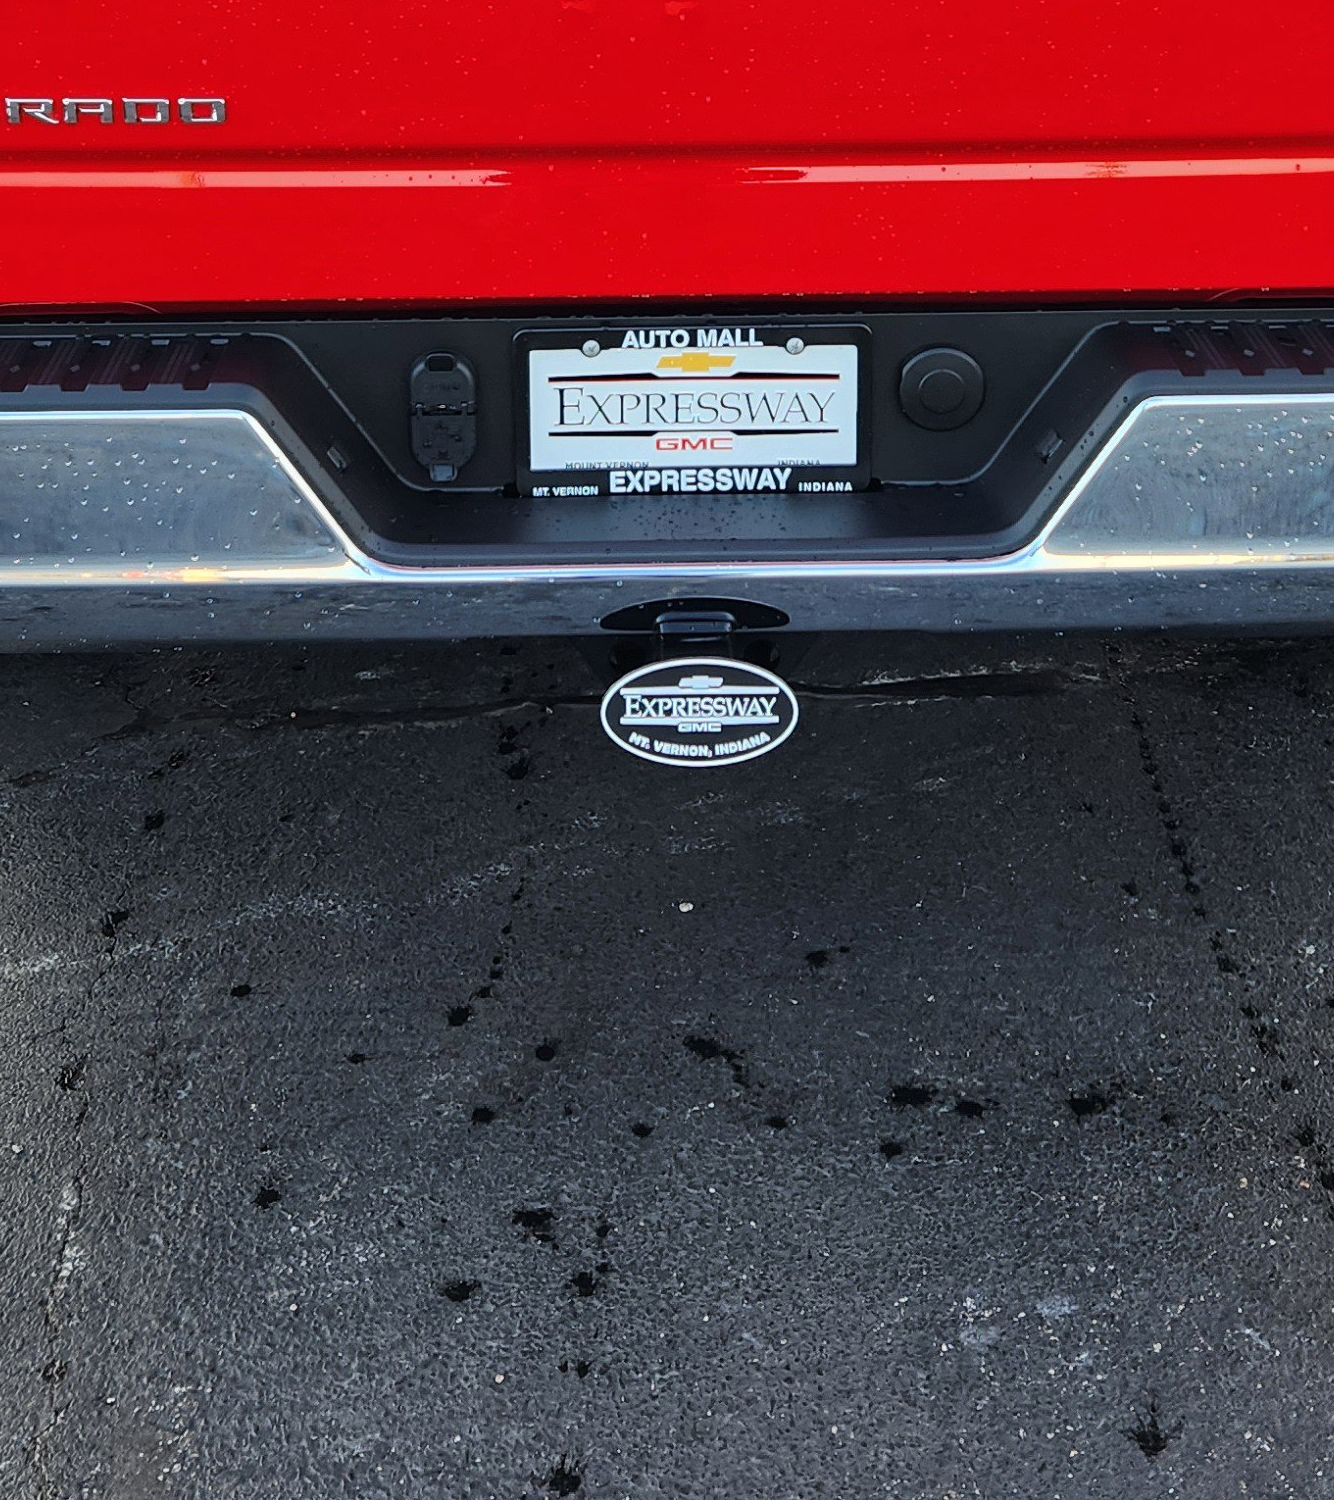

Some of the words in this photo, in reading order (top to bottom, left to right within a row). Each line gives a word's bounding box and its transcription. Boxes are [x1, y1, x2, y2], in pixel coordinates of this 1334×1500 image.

[621, 329, 691, 349] AUTO
[697, 328, 764, 348] MALL
[655, 437, 733, 451] GMC
[565, 462, 602, 470] MOUNT
[606, 461, 650, 470] VERNON
[609, 467, 792, 494] EXPRESSWAY
[798, 481, 853, 492] INDIANA
[532, 486, 550, 497] MT.
[552, 485, 599, 496] VERNON
[677, 722, 722, 733] GMC
[628, 731, 650, 750] MT.
[715, 731, 771, 756] INDIANA
